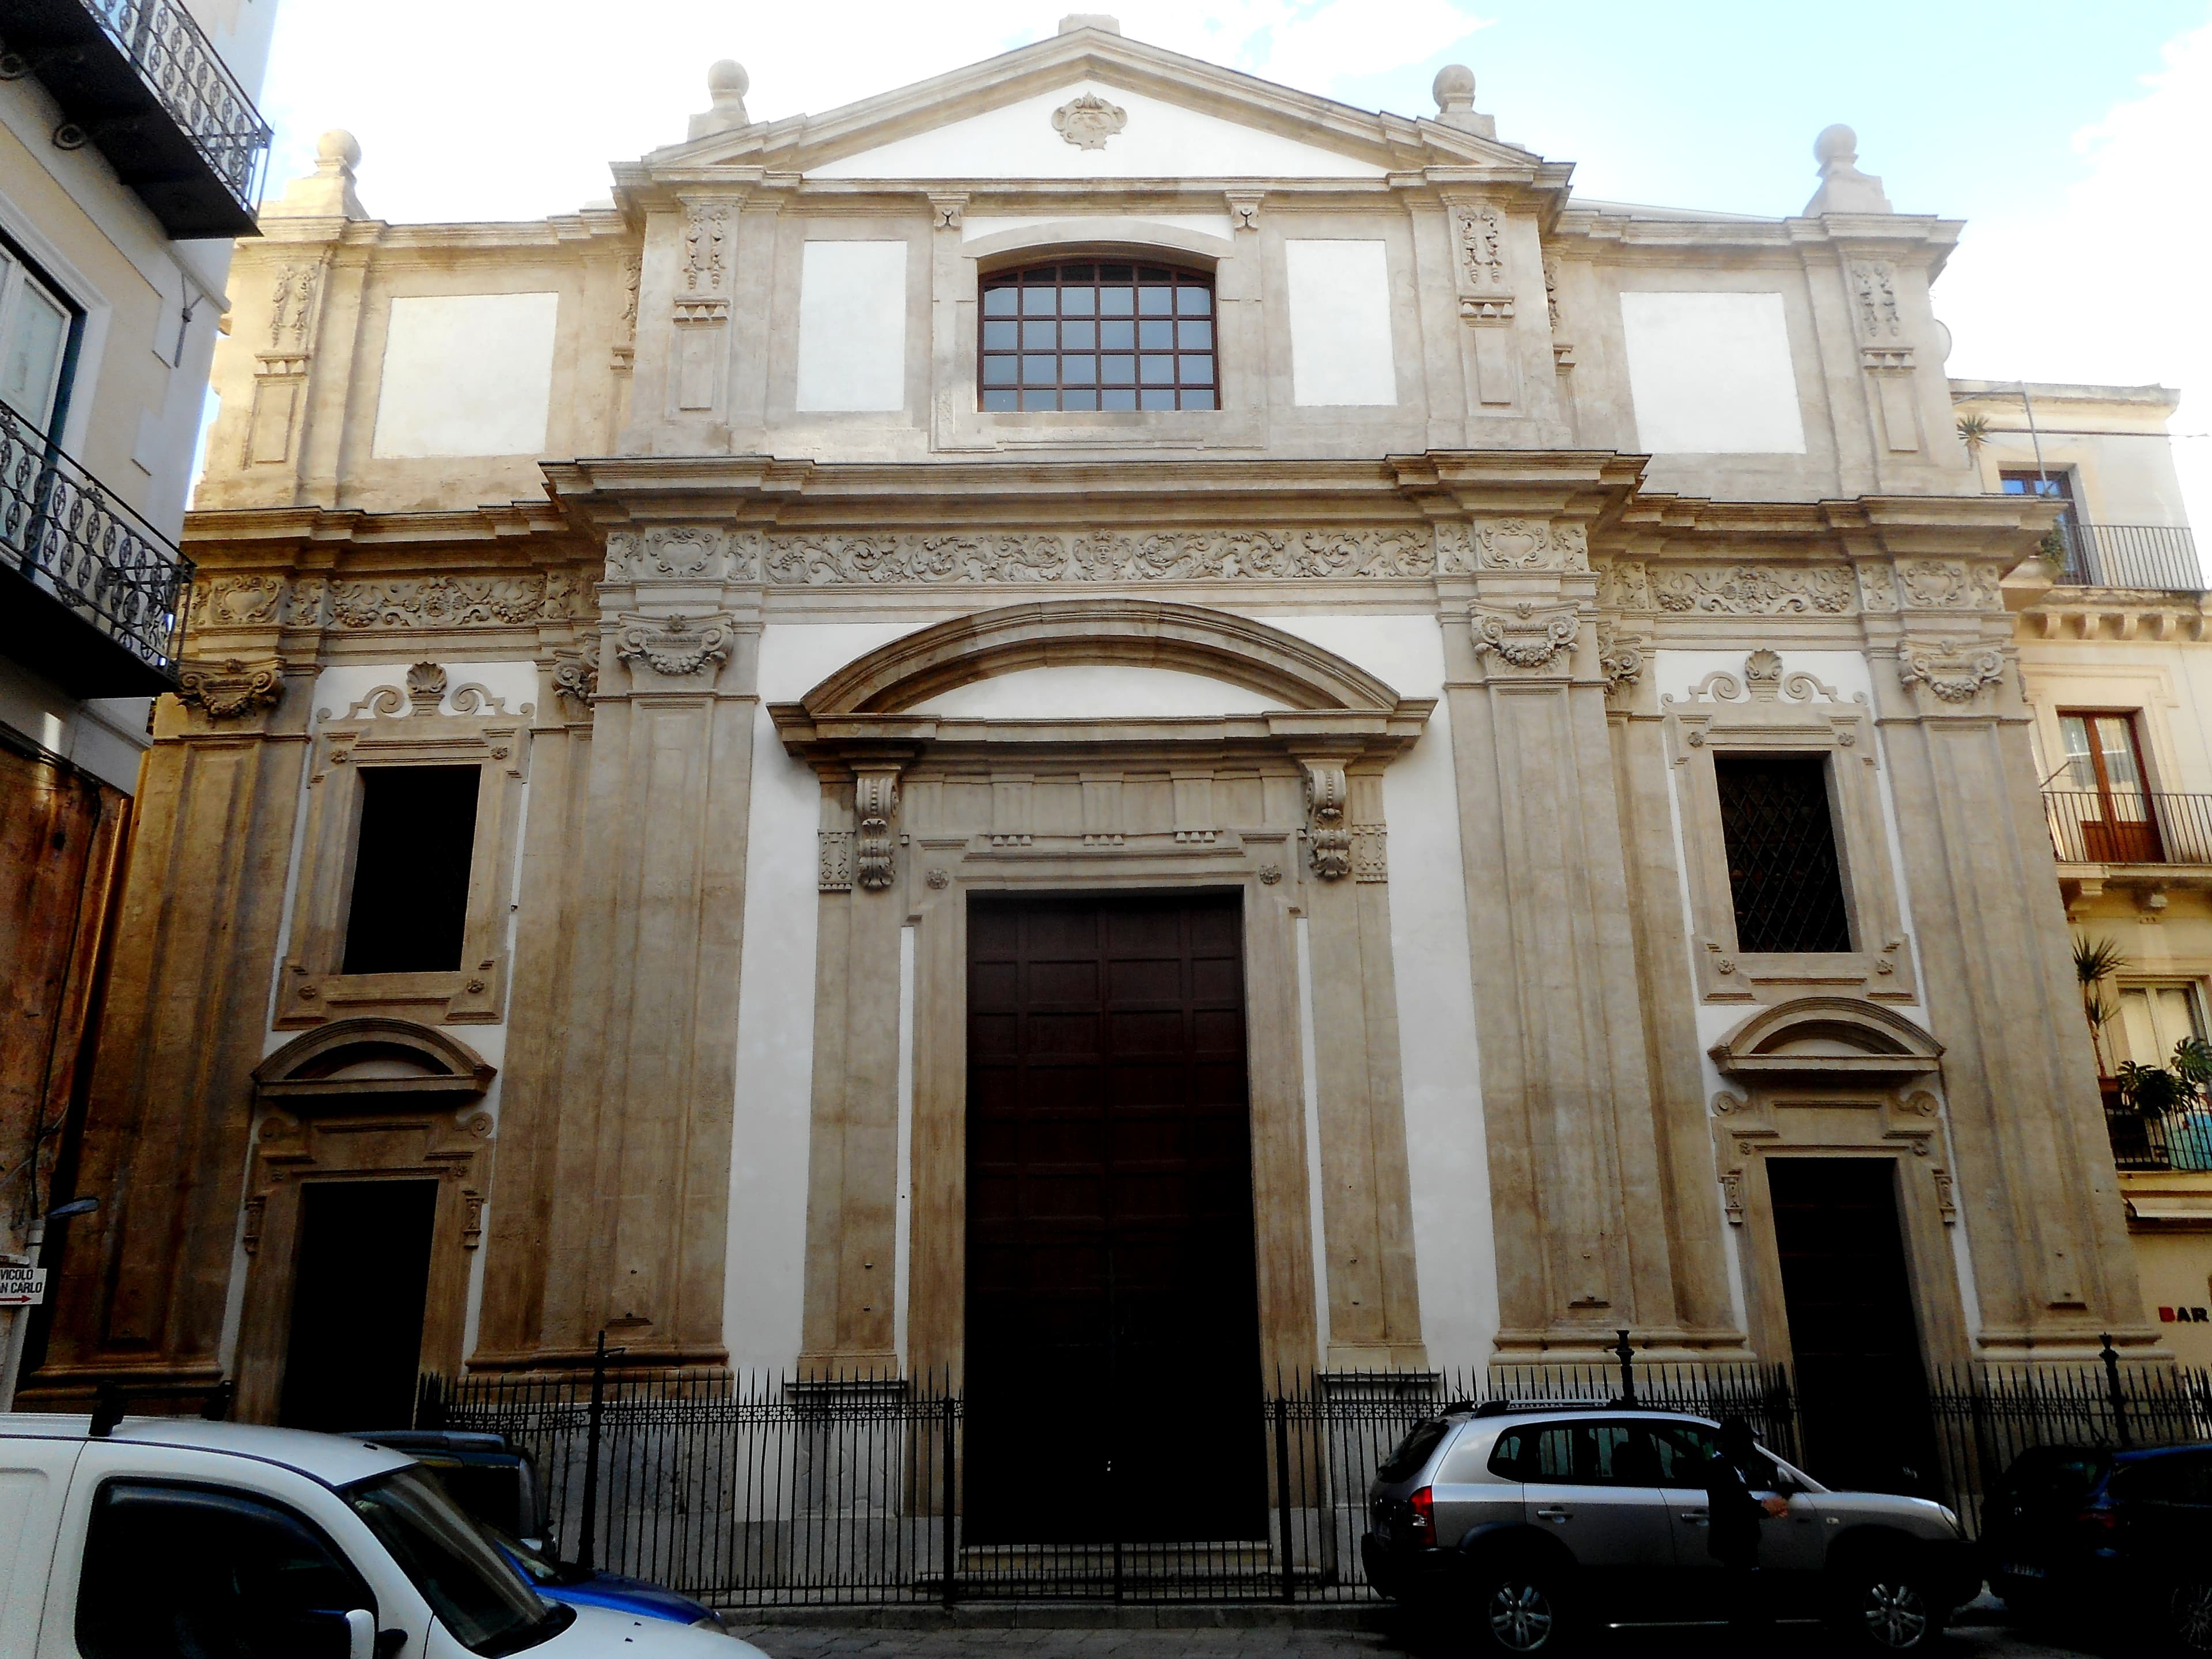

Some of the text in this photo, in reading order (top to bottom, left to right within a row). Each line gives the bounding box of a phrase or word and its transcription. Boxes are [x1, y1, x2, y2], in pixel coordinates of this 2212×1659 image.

[1, 1269, 33, 1280] VICOLO
[12, 1282, 42, 1293] CARLO
[2158, 1307, 2209, 1323] BAR
